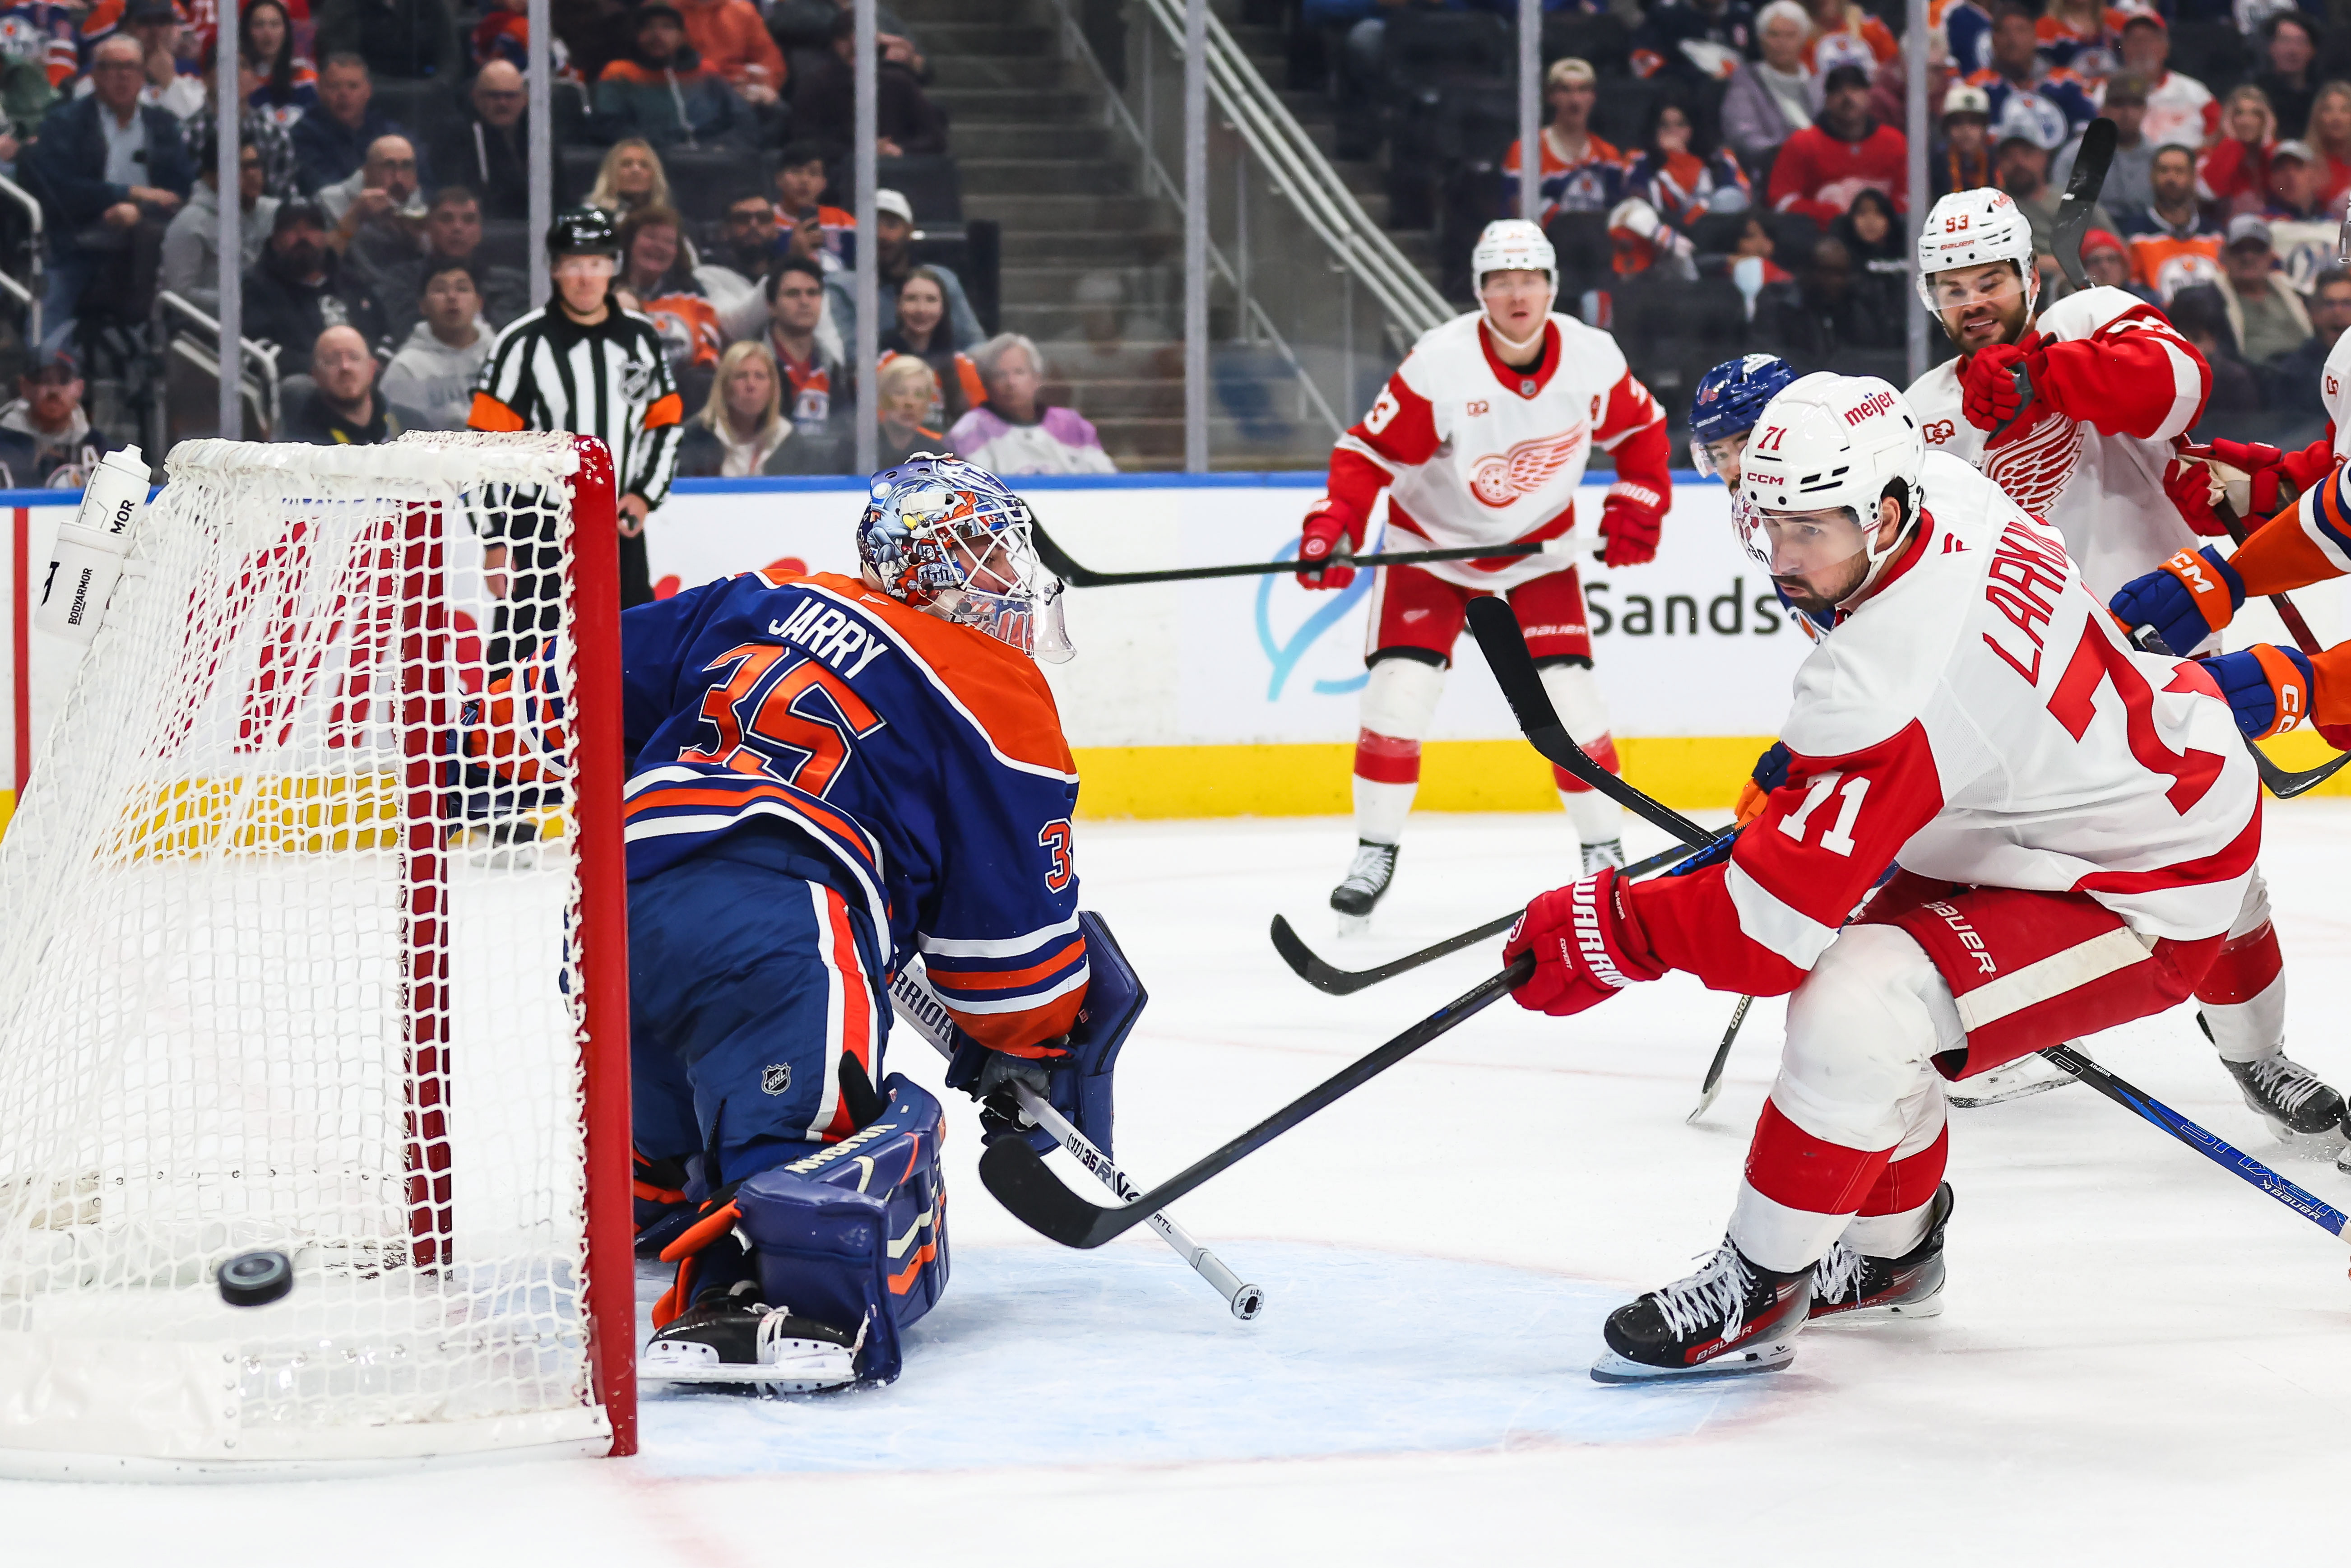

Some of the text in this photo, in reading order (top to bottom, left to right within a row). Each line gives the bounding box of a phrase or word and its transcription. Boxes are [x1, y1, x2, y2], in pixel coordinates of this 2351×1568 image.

[1945, 214, 1969, 233] 53
[1844, 390, 1895, 427] meijer
[1757, 426, 1788, 450] 71
[1747, 472, 1785, 486] CCM
[68, 567, 93, 626] BODYARMOR
[2168, 551, 2215, 594] CM
[1584, 576, 1781, 636] Sands
[768, 596, 889, 680] JARRY
[676, 643, 887, 800] 35
[2272, 683, 2300, 736] CC
[1777, 769, 1871, 857] 71
[1038, 817, 1074, 894] 3
[1572, 874, 1634, 988] WARRIO
[893, 970, 954, 1044] RRIOR
[2089, 1062, 2112, 1078] MURPHY
[1082, 1148, 1099, 1174] 35
[1154, 1213, 1172, 1234] RTL
[2270, 1188, 2322, 1221] BAUER
